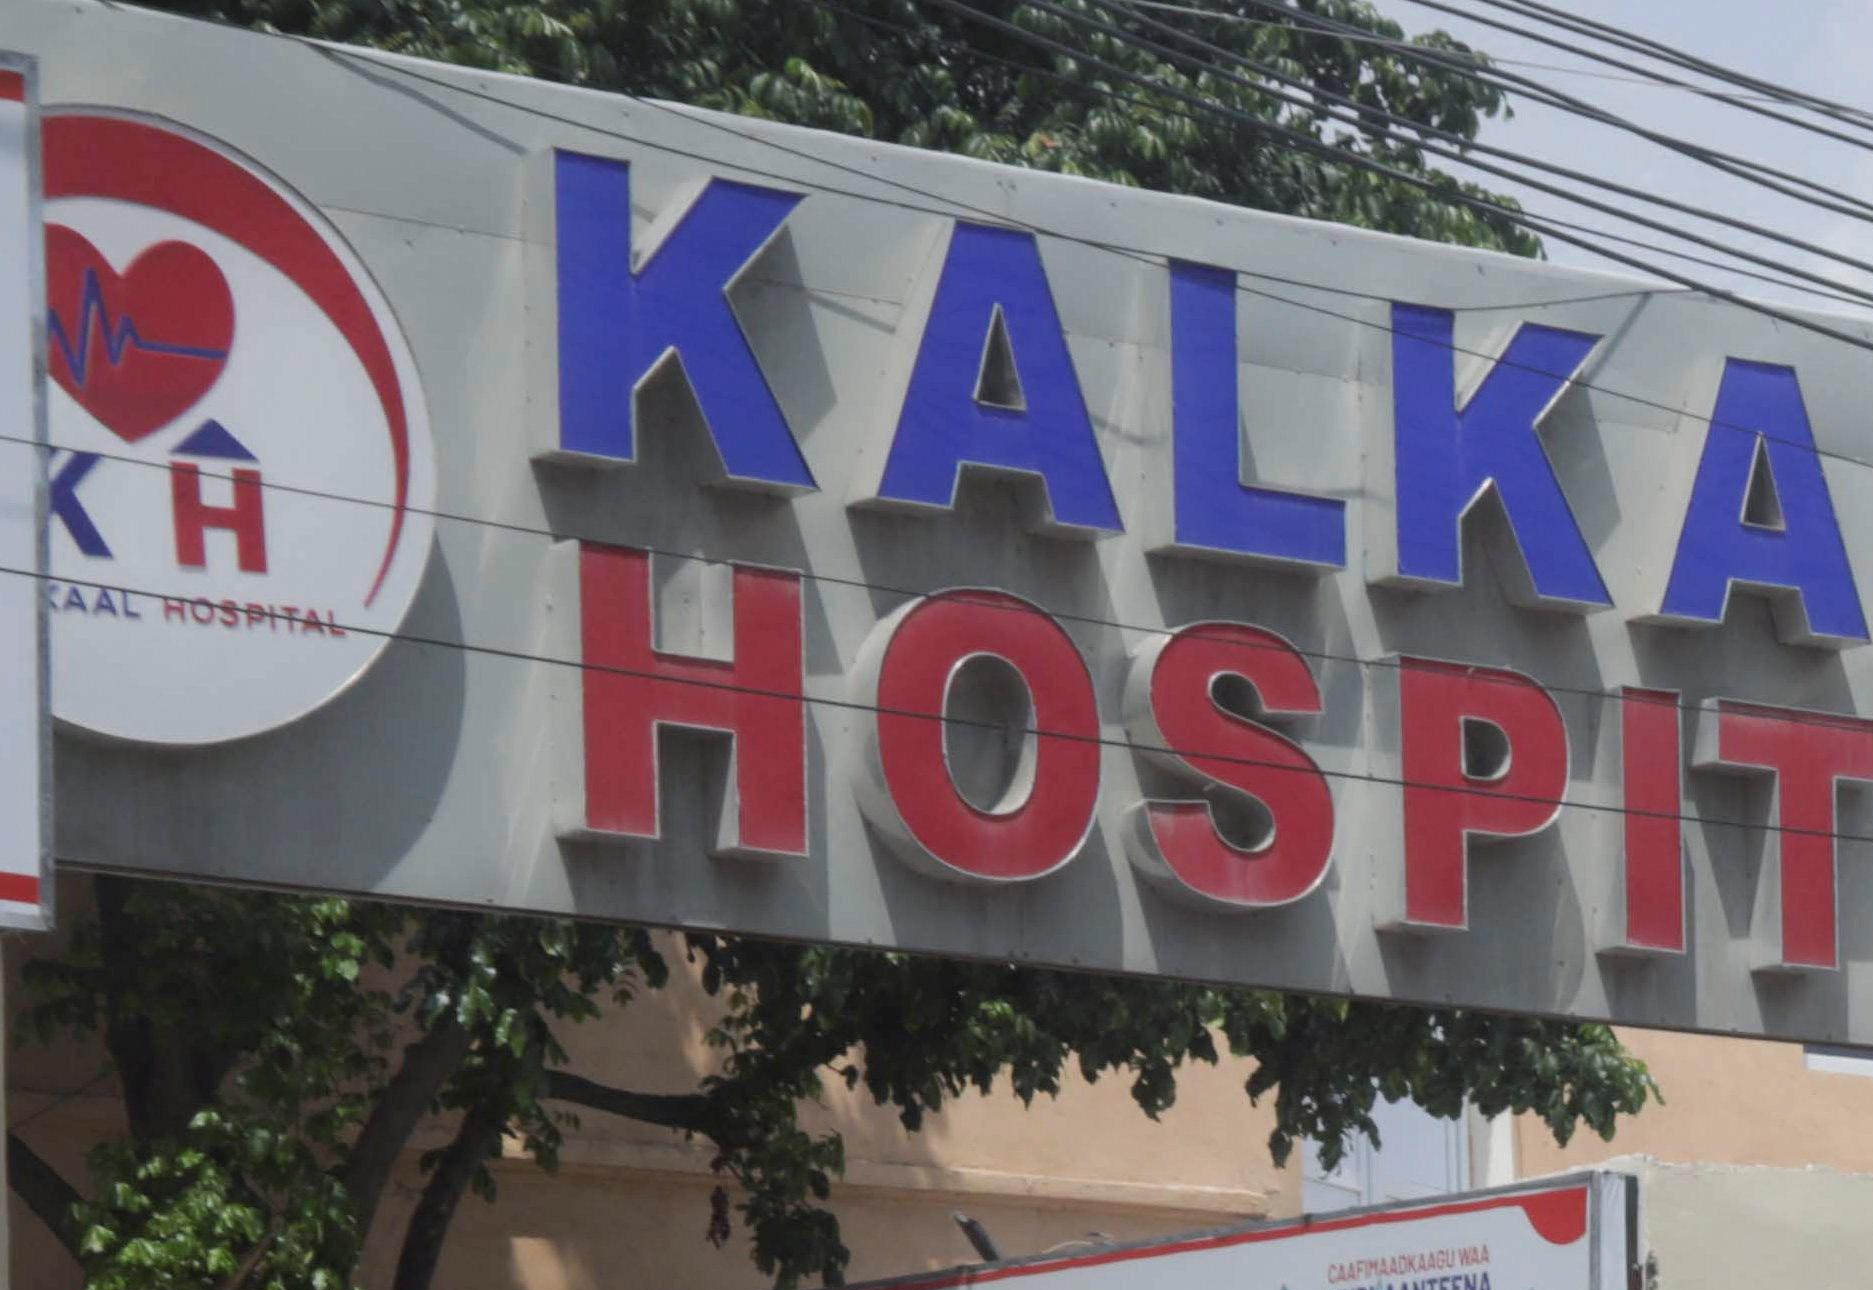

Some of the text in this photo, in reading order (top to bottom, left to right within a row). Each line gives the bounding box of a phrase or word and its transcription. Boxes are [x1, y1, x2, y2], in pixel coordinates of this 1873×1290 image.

[163, 596, 347, 637] HOSPITAL
[1328, 1244, 1490, 1285] CAAFIMAADKAAGU WAA
